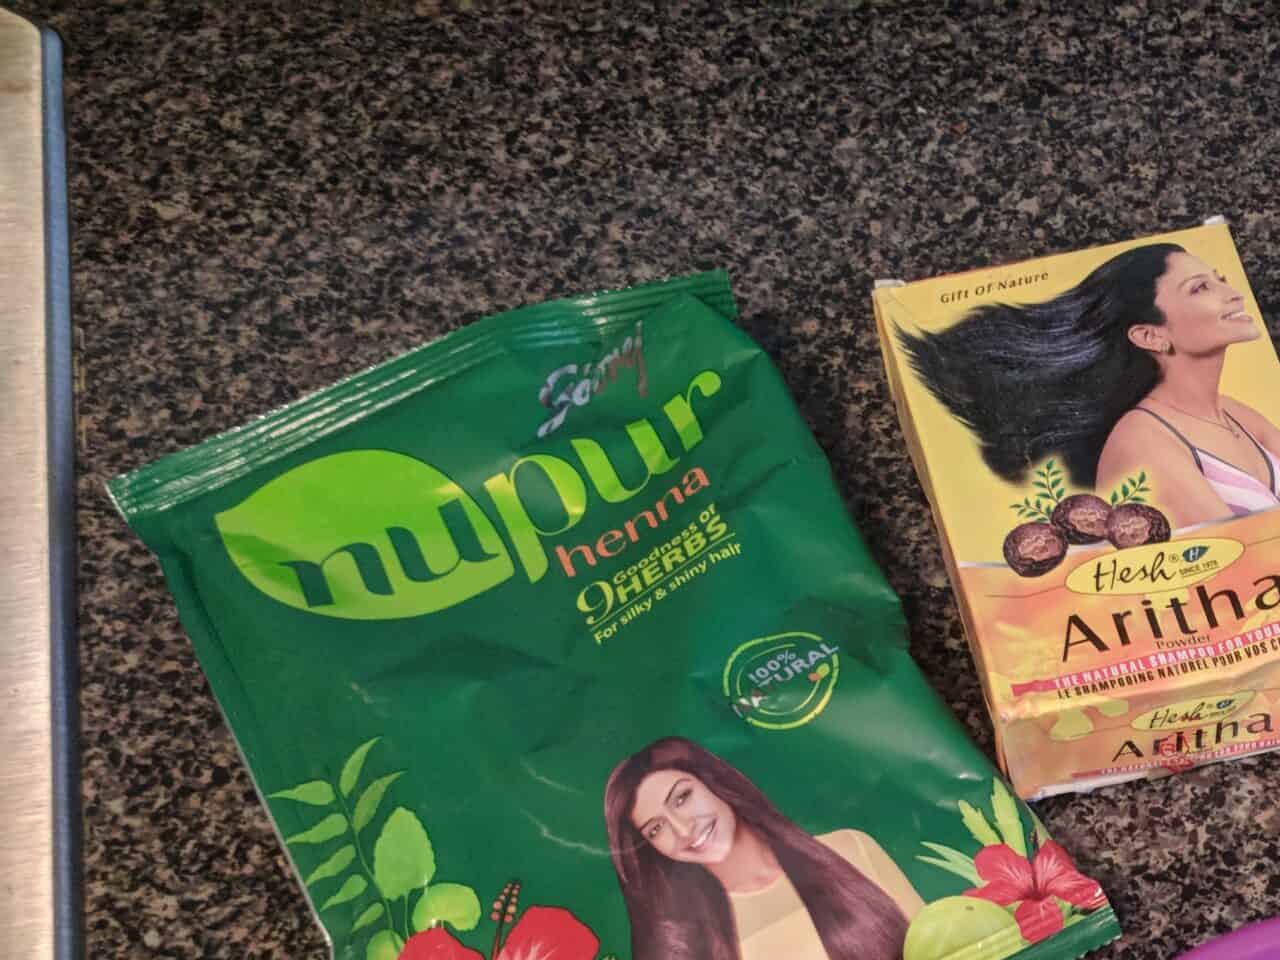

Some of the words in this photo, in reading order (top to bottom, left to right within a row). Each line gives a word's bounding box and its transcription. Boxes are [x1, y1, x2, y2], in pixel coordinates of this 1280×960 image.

[940, 289, 969, 304] Gift
[975, 282, 993, 297] Of
[997, 272, 1049, 290] Nature
[279, 370, 721, 609] nupur
[555, 466, 711, 578] henna
[612, 521, 698, 585] Goodness
[699, 502, 717, 524] of
[576, 580, 615, 625] 9
[615, 513, 728, 604] HERBS
[593, 622, 619, 646] For
[619, 597, 652, 625] silky
[654, 587, 667, 601] &
[668, 560, 708, 591] shiny
[708, 542, 742, 564] hair
[1092, 551, 1178, 593] Hesh
[747, 648, 797, 684] 100%
[1054, 675, 1081, 689] THE
[1082, 658, 1147, 684] NATURAL
[1148, 645, 1216, 669] SHAMPOO
[1217, 636, 1243, 655] FOR
[1154, 634, 1212, 650] Powder
[1056, 688, 1072, 699] LE
[1073, 671, 1155, 697] SHAMPOOING
[1156, 658, 1210, 681] NATUREL
[1211, 651, 1243, 669] POUR
[1244, 642, 1269, 660] VOS
[1111, 712, 1275, 763] Aritha
